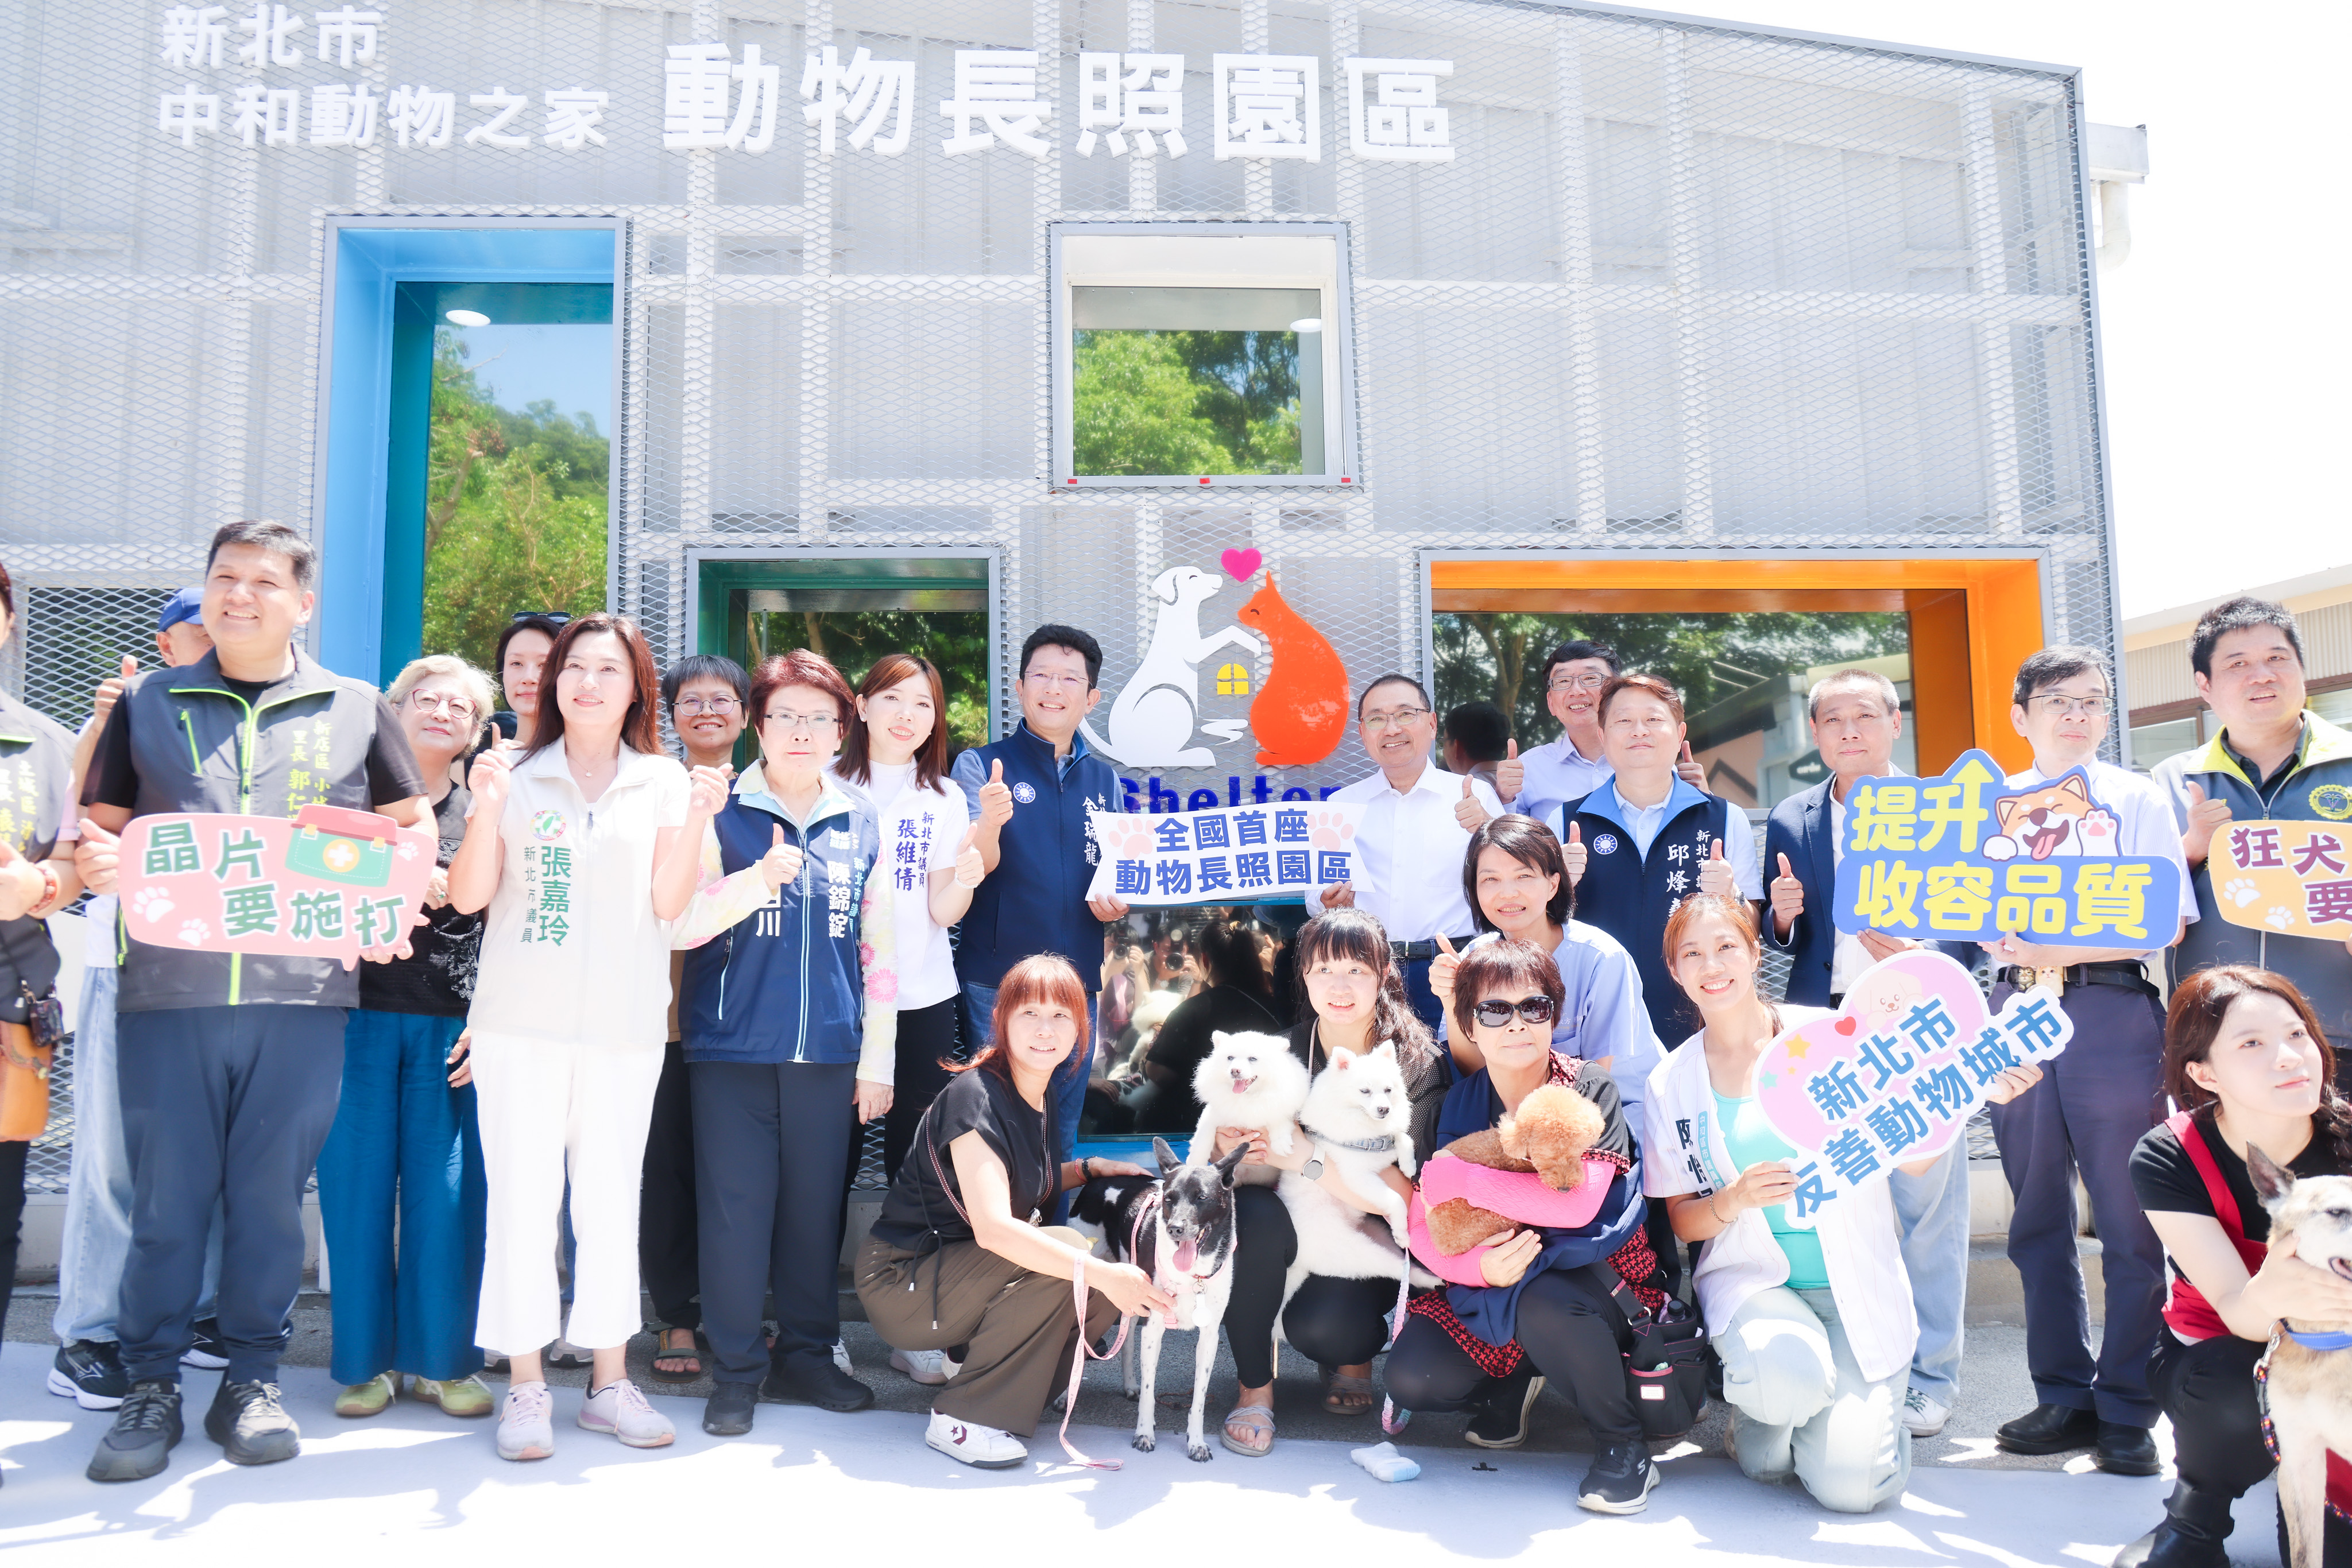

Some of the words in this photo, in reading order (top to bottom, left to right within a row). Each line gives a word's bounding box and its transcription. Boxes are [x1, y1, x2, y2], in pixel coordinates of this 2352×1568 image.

[161, 4, 382, 69] 新北市
[159, 84, 609, 150] 中和動物之家
[663, 43, 1454, 163] 動物長照園區
[290, 730, 310, 761] 里長
[313, 719, 332, 770] 新店區
[287, 768, 311, 819] 郭仁
[1850, 759, 1995, 853] 提升
[145, 822, 265, 880] 晶片
[894, 819, 919, 891] 張維倩
[918, 811, 935, 888] 新北市議員
[1154, 808, 1310, 853] 全國首座
[2230, 827, 2346, 876] 狂犬
[520, 846, 537, 943] 新北市議員
[537, 846, 571, 946] 張嘉玲
[827, 860, 852, 938] 陳錦錠
[1115, 850, 1352, 896] 動物長照園區
[1854, 860, 2152, 939] 收容品質
[2304, 880, 2352, 923] 要
[223, 882, 405, 946] 要施打
[1808, 998, 1956, 1122] 新北市
